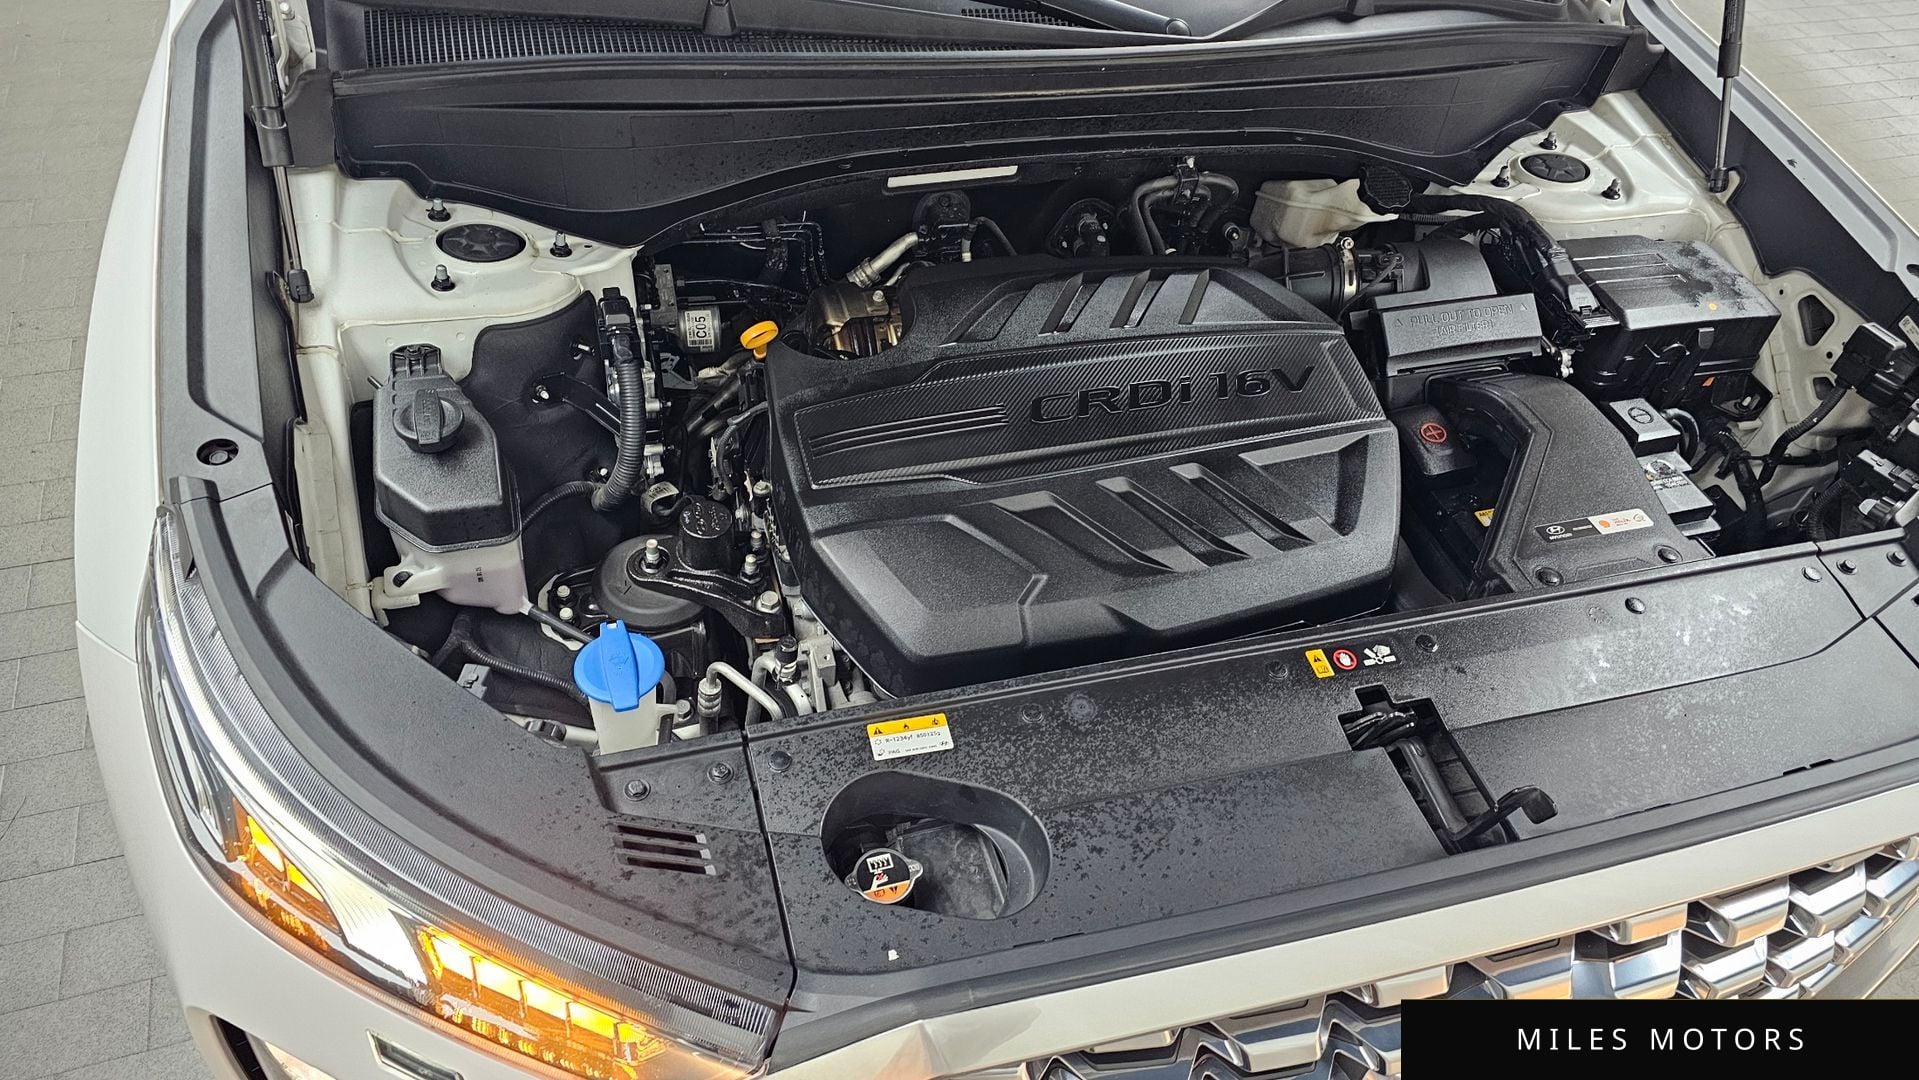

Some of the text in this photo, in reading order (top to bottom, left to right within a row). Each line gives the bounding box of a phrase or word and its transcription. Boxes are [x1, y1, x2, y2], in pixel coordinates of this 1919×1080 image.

[1410, 303, 1514, 327] PULL OUT TO OPEN
[695, 316, 707, 339] C05
[1031, 365, 1316, 424] CRDi 16V
